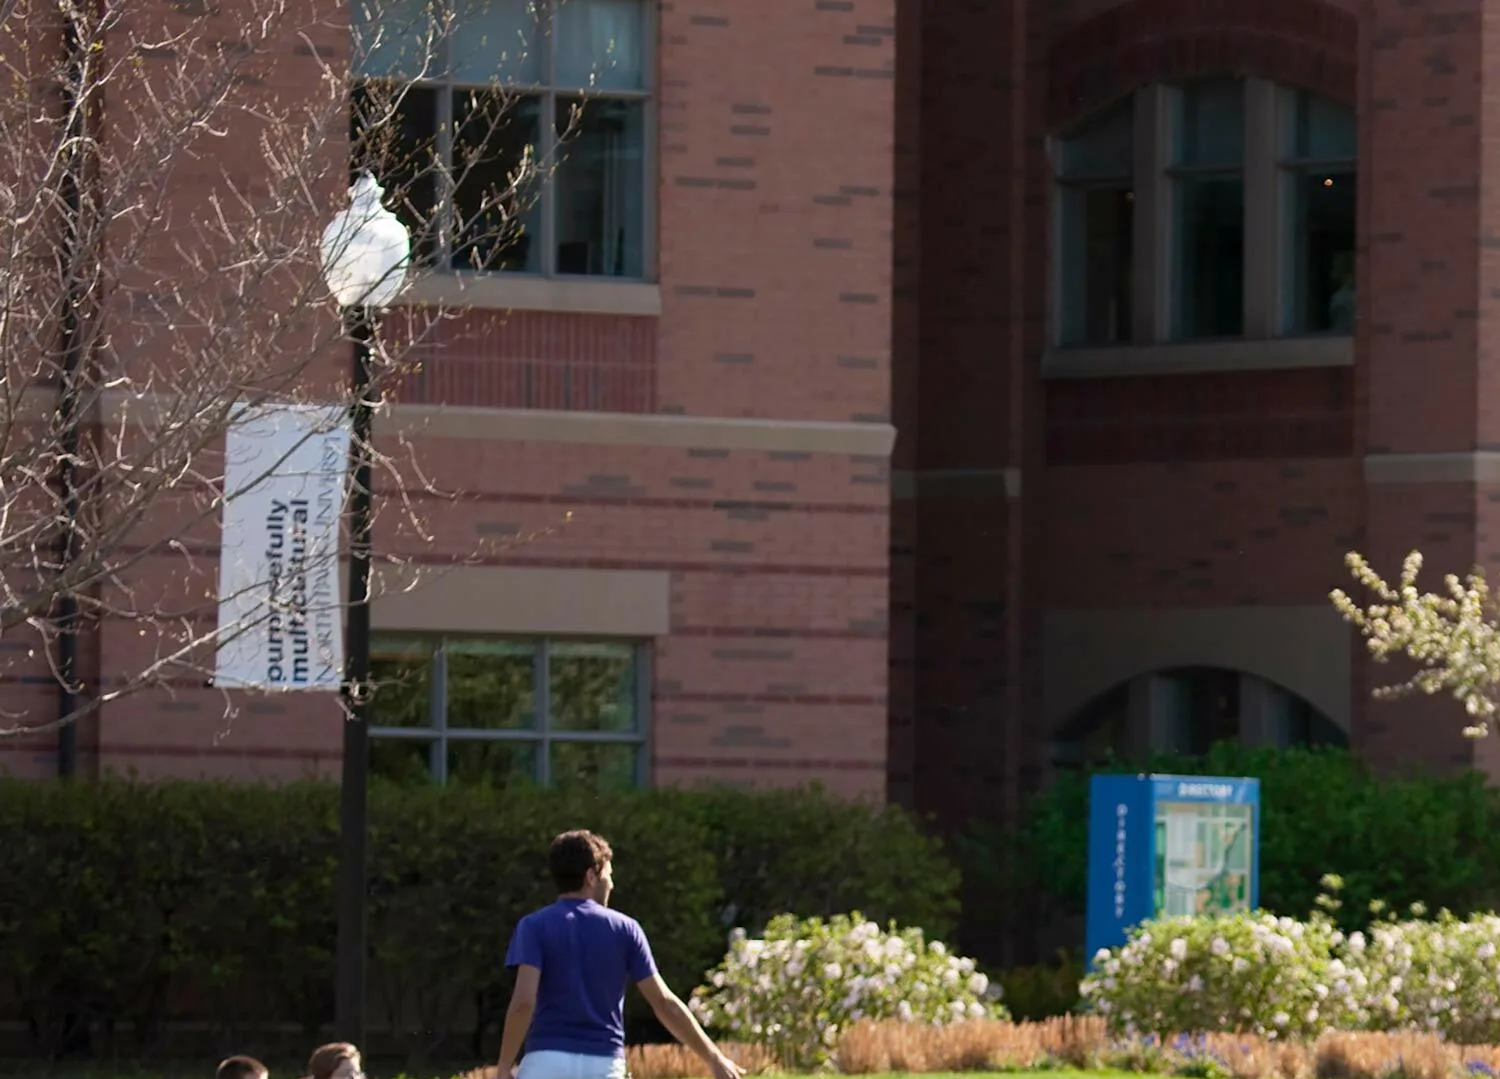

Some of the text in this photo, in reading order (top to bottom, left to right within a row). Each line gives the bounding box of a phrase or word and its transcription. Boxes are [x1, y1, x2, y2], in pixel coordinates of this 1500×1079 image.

[312, 428, 341, 541] UNIVERSIT
[266, 498, 289, 683] purpefully
[1178, 783, 1233, 798] DIRECTORY
